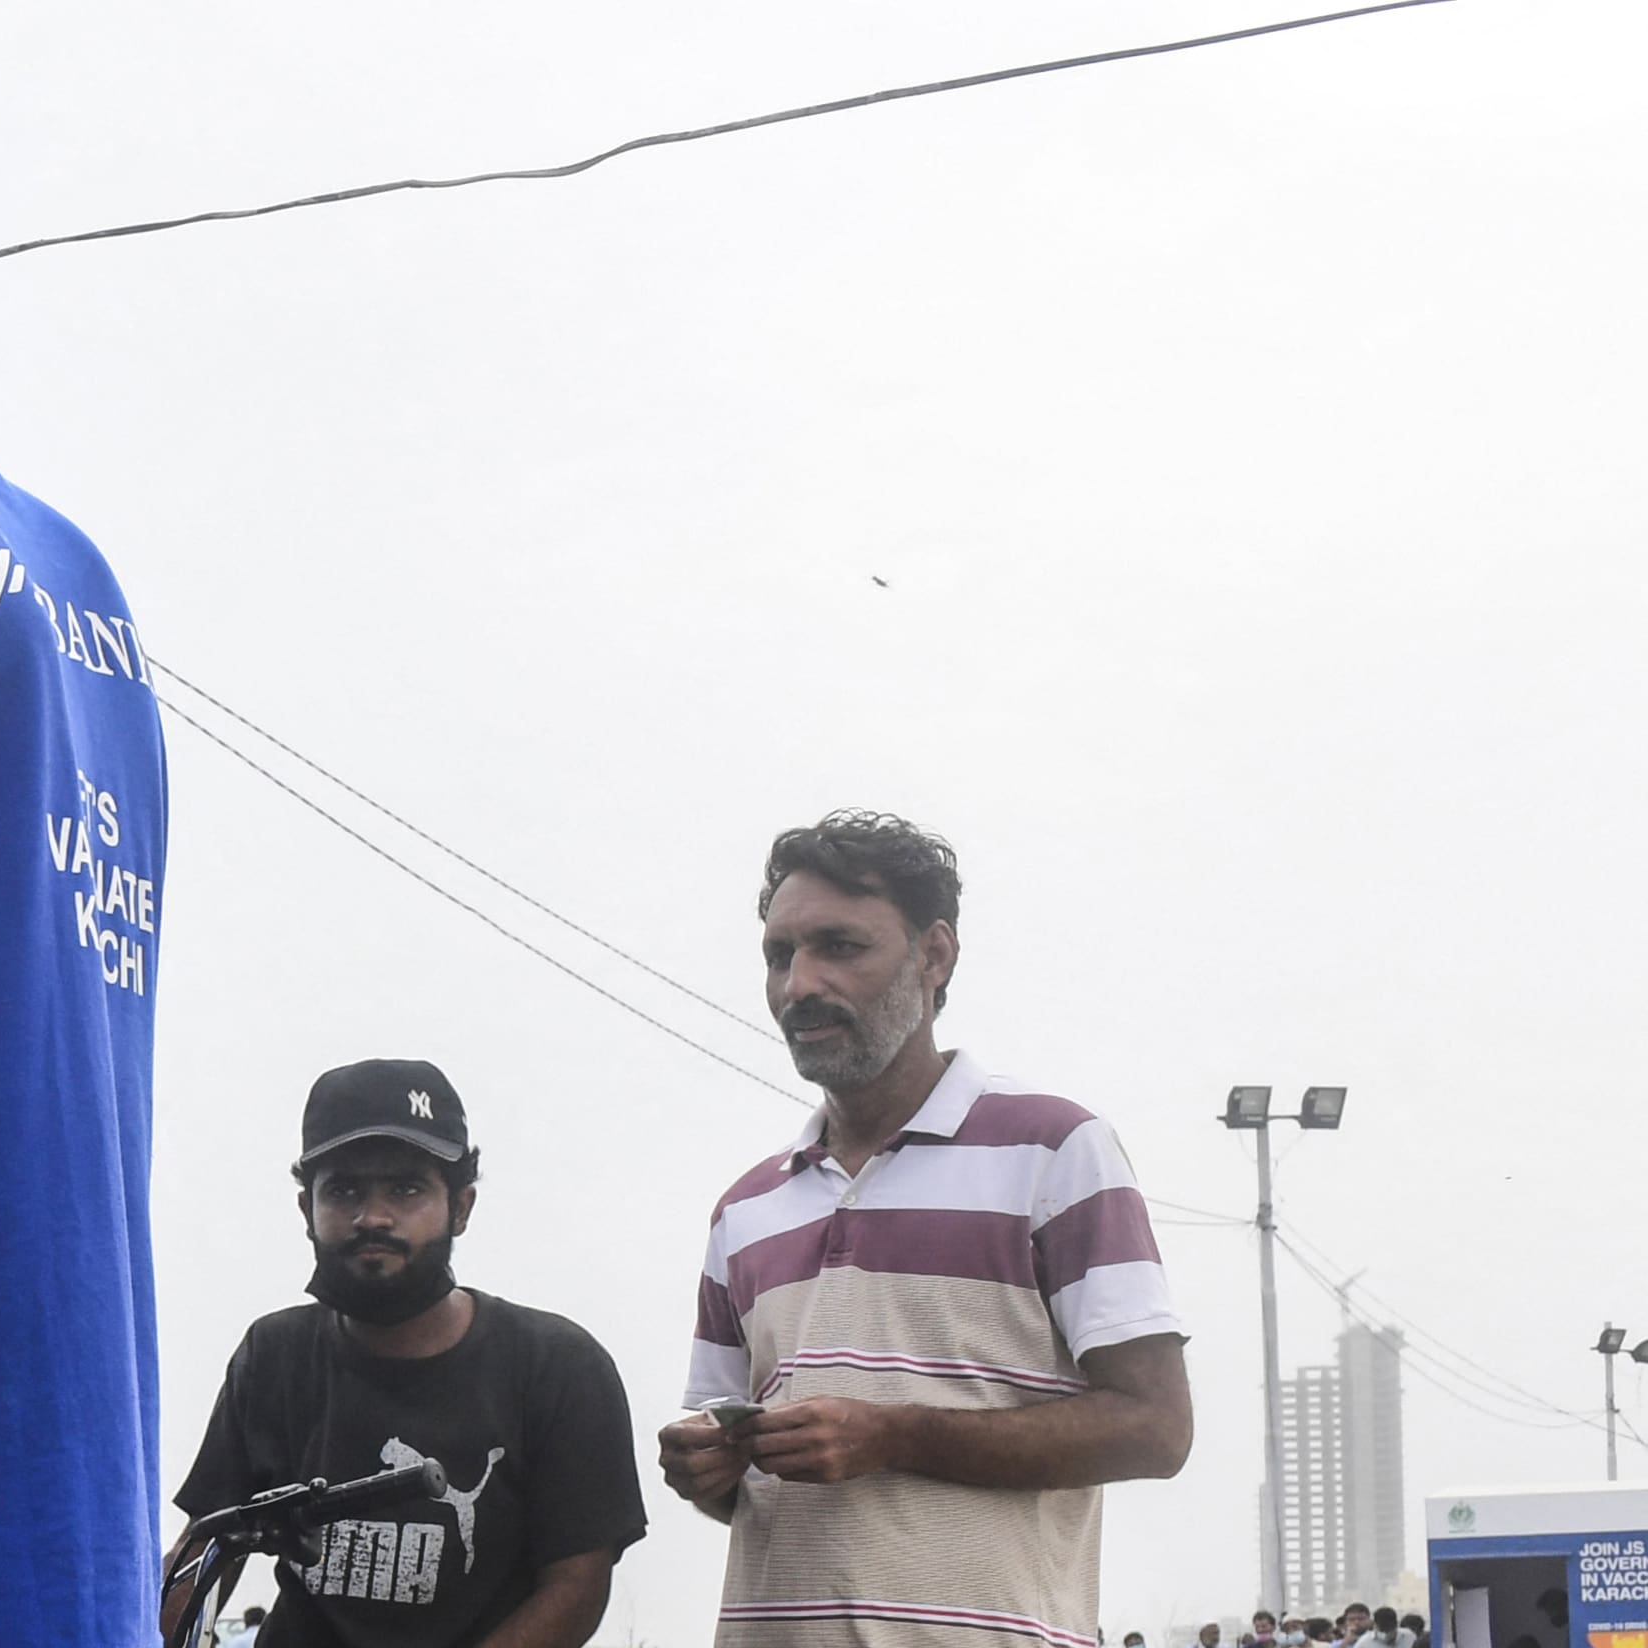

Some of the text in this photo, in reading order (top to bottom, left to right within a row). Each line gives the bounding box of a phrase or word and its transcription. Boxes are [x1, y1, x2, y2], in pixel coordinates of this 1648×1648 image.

[408, 1089, 434, 1120] NY
[1579, 1540, 1645, 1557] JOIN JS
[1581, 1571, 1648, 1586] IN VACC
